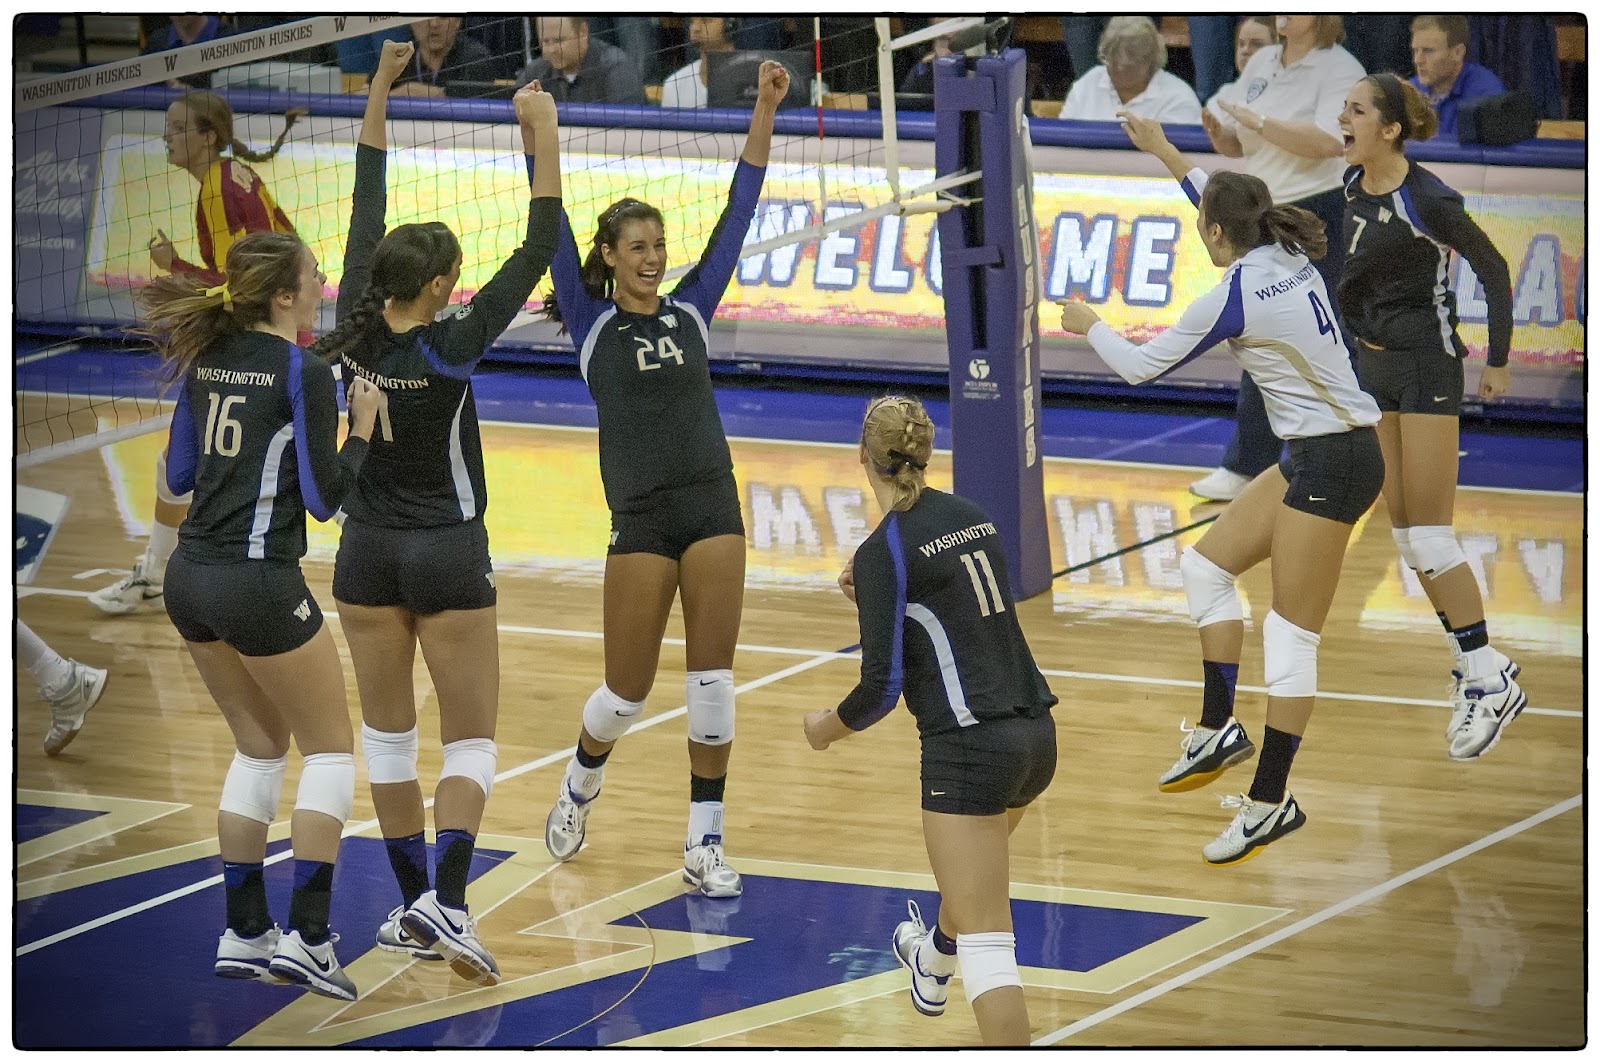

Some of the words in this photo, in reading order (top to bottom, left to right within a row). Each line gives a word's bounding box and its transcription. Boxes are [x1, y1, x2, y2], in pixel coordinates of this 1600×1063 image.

[334, 16, 347, 33] W
[200, 36, 266, 63] WASHINGTON
[269, 24, 313, 47] HUSKIES
[164, 54, 178, 72] W
[22, 74, 91, 101] WASHINGTON
[95, 63, 142, 86] HUSKIES
[1349, 214, 1367, 254] 7
[658, 313, 679, 329] W
[1307, 290, 1338, 345] 4
[341, 351, 429, 390] WASHINGTON
[633, 335, 685, 371] 24
[197, 366, 276, 387] WASHINGTON
[204, 391, 247, 458] 16
[919, 522, 997, 558] WASHINGTON
[960, 549, 1006, 617] 11
[293, 598, 312, 622] W
